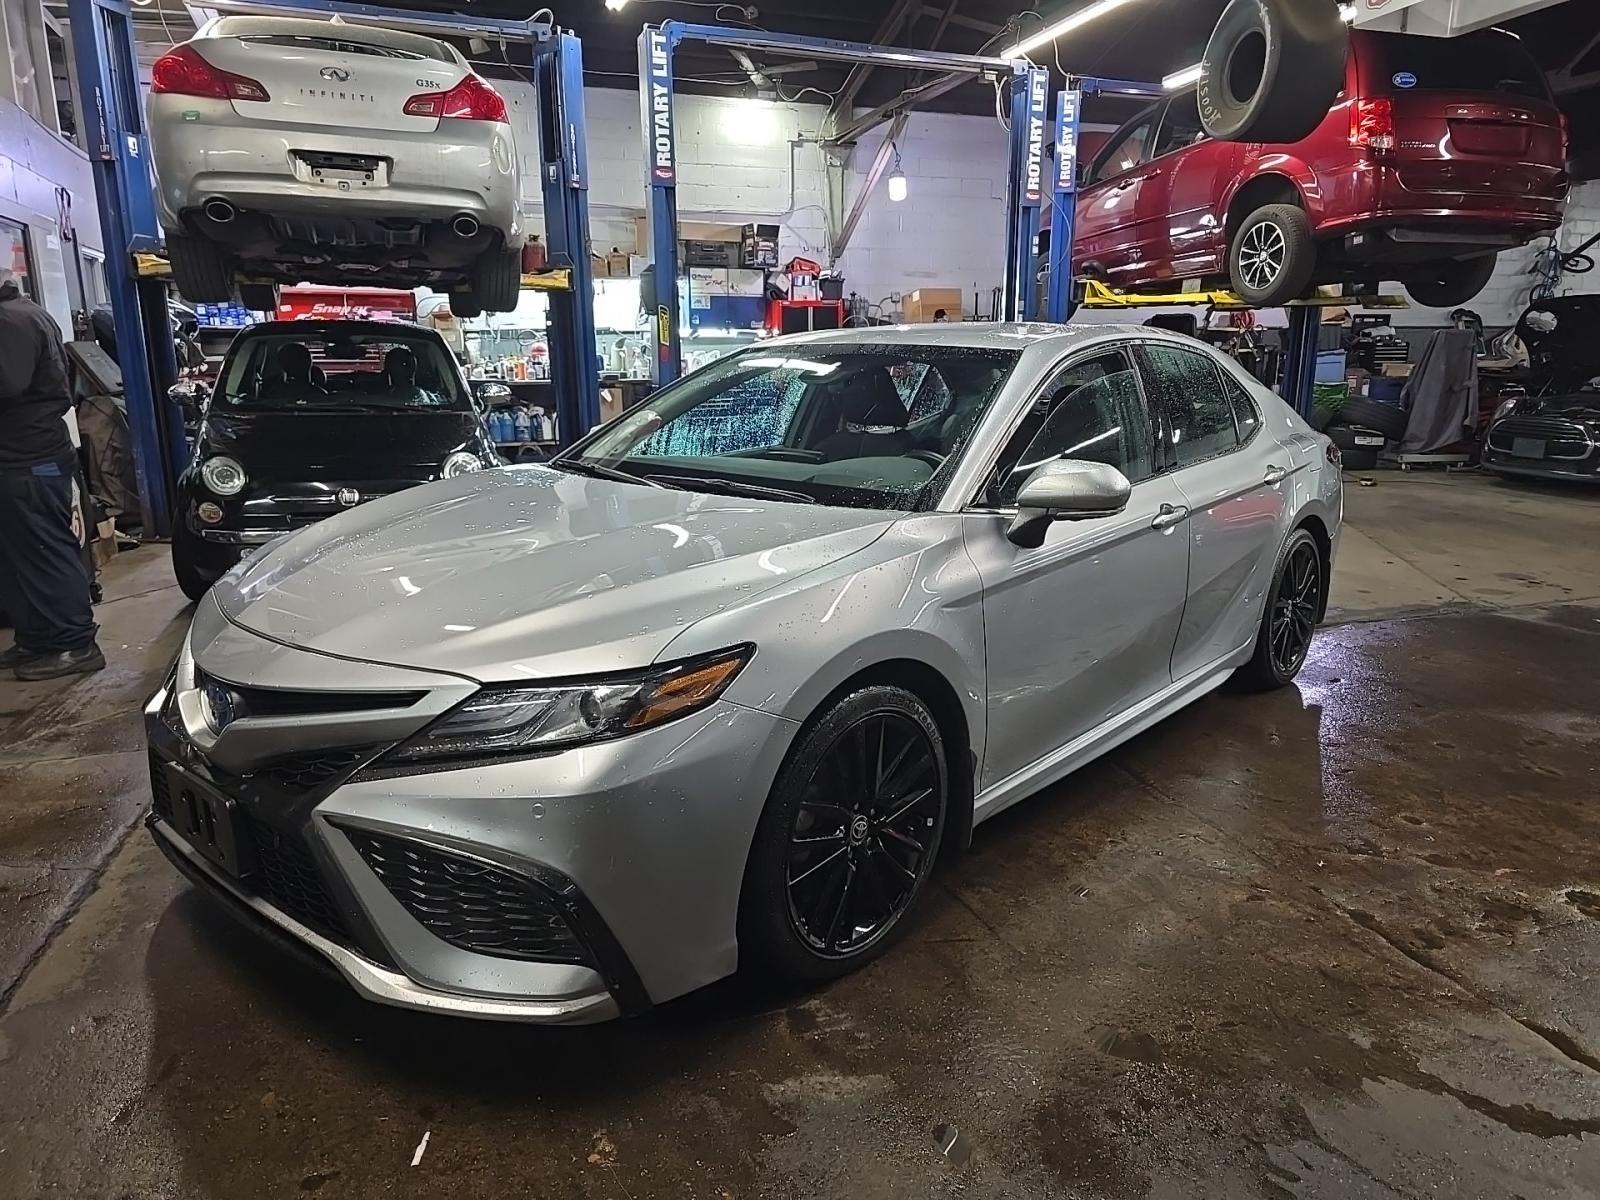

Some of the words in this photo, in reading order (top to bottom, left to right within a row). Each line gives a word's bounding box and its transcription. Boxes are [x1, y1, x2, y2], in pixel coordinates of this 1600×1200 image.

[651, 31, 668, 77] LIFT
[299, 87, 375, 103] INFINITI
[415, 78, 441, 90] G35x
[1031, 71, 1047, 112] LIFT
[653, 82, 672, 167] ROTARY
[1063, 93, 1075, 122] LIFT
[1027, 116, 1043, 191] ROTARY
[1060, 125, 1074, 180] ROTARY
